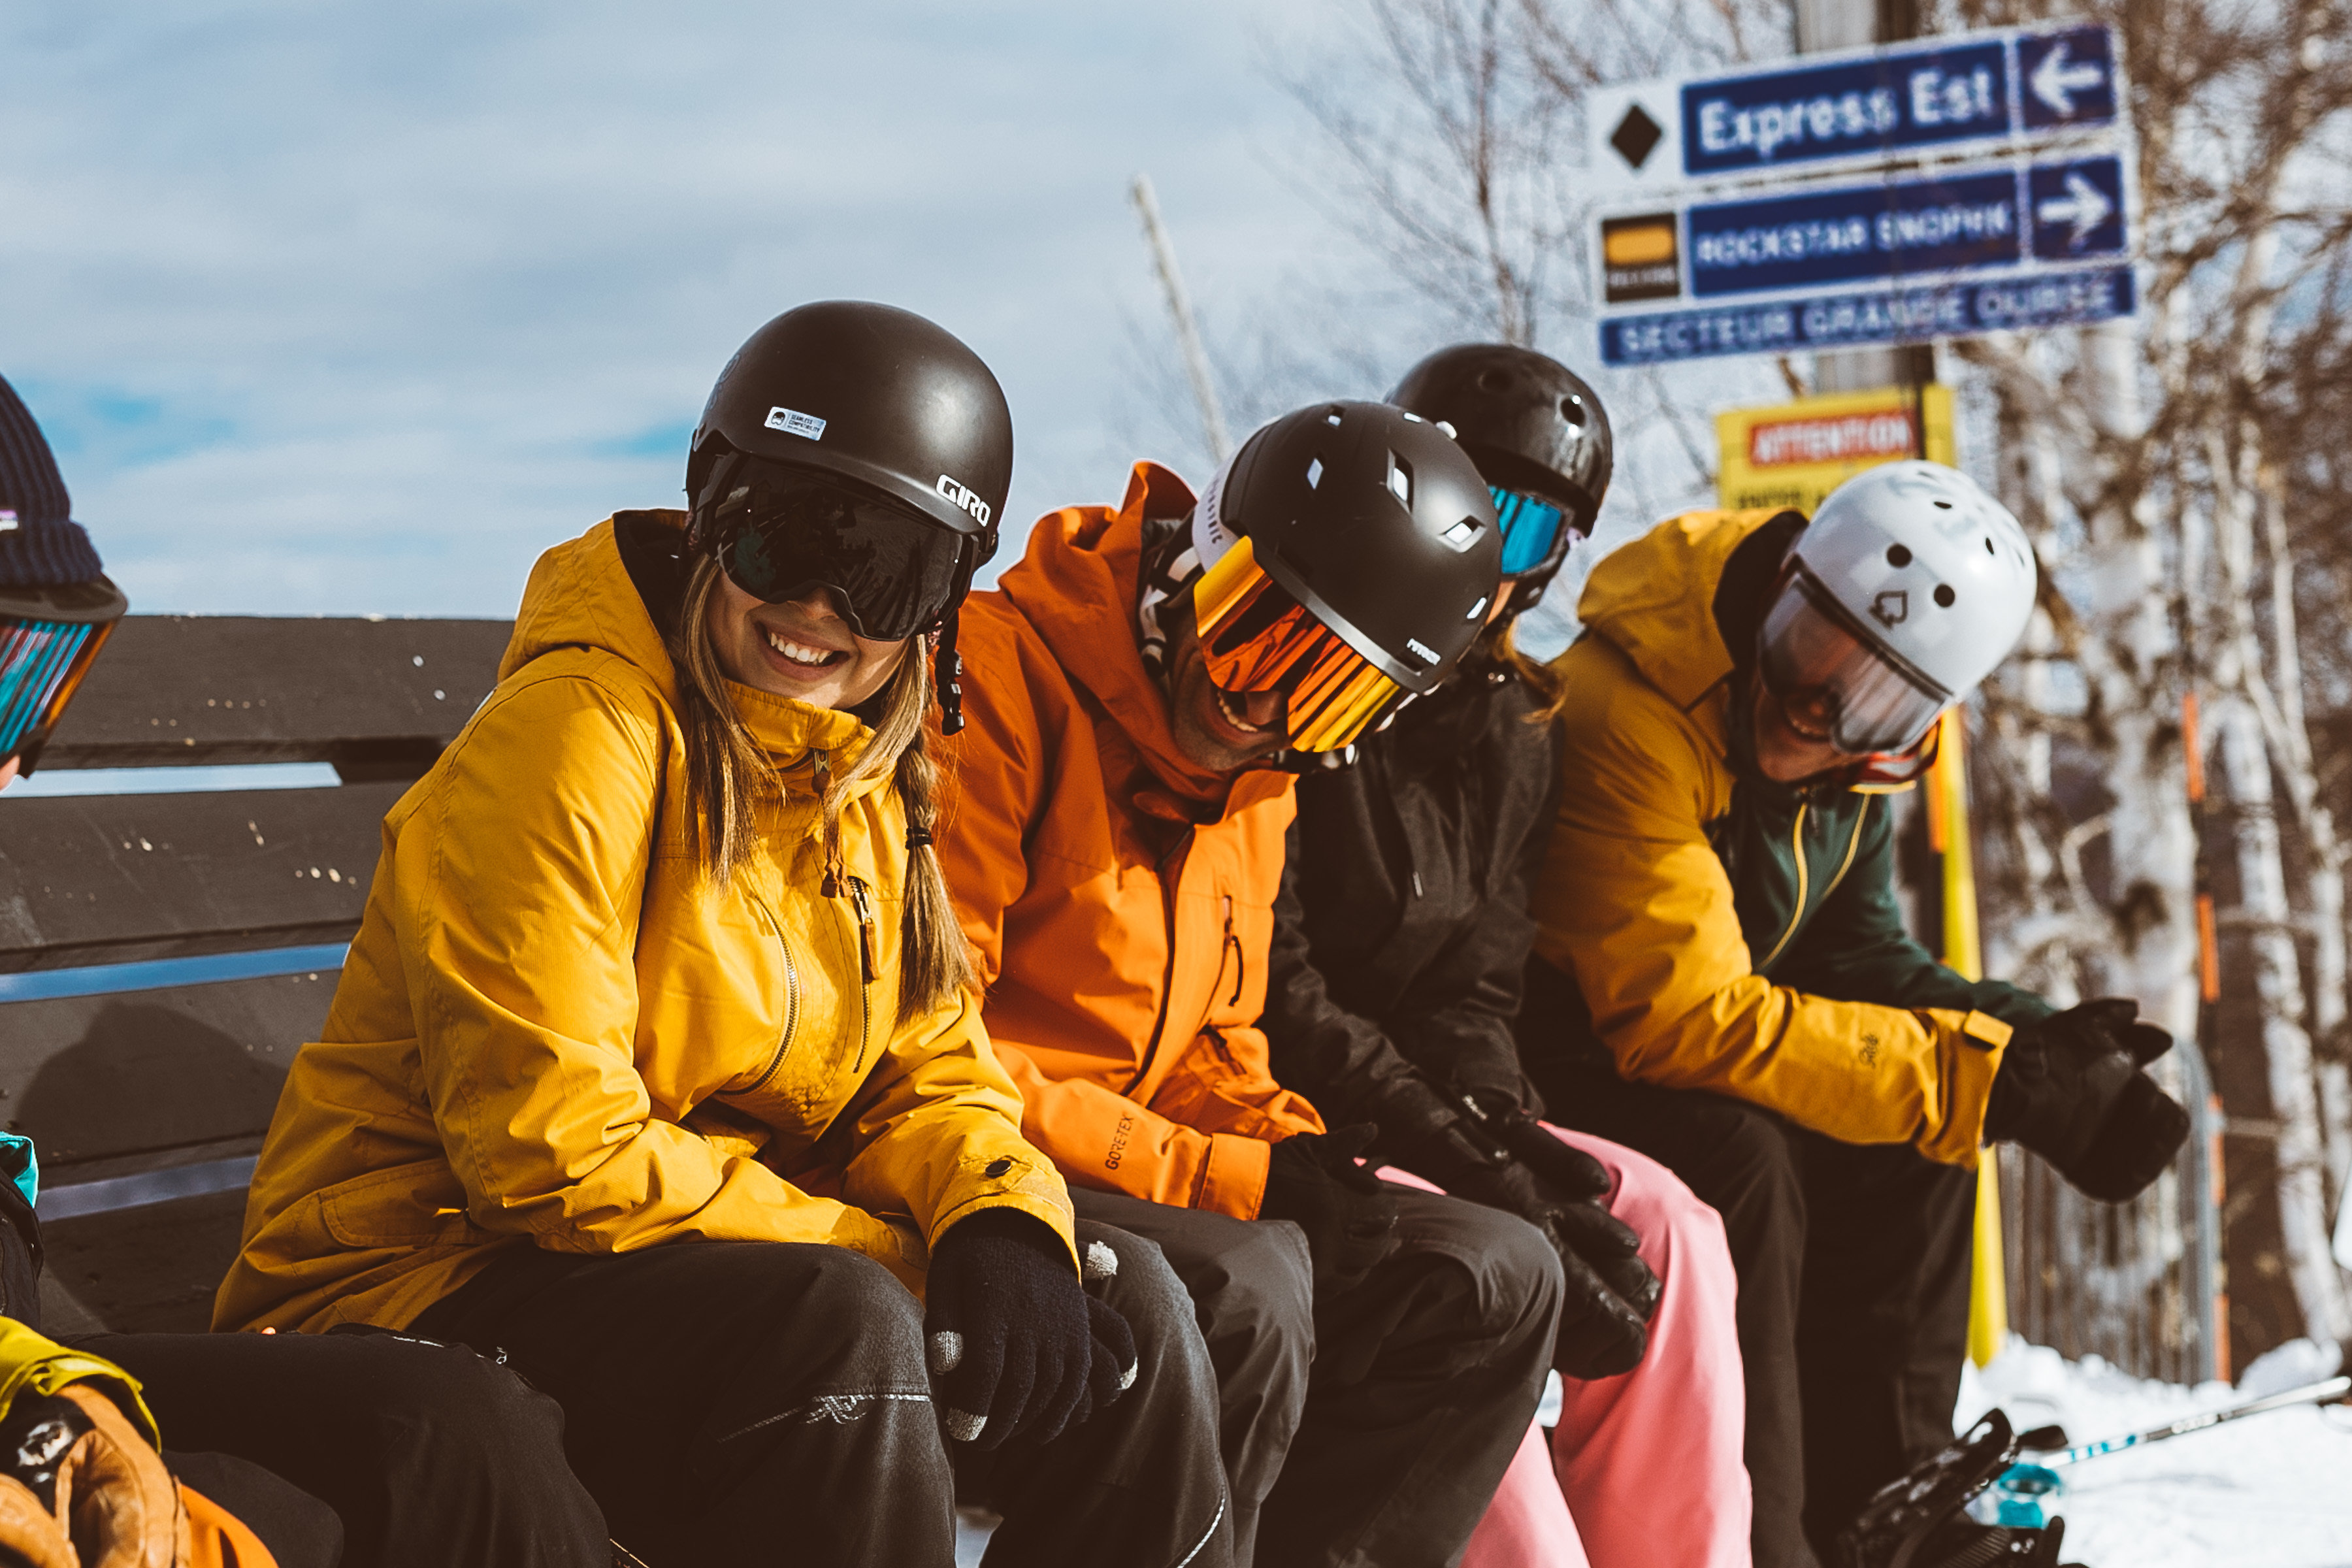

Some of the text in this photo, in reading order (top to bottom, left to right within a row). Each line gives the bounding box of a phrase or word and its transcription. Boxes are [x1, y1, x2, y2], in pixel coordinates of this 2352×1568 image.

[1700, 67, 1993, 159] Express Est
[1697, 216, 1869, 266] ROCKSTAR
[1619, 279, 2114, 353] SECTEUR GRANDE OURSE
[1754, 414, 1908, 463] ATTENTION
[936, 474, 990, 527] GIRO
[1105, 1113, 1134, 1170] GORE-TEX
